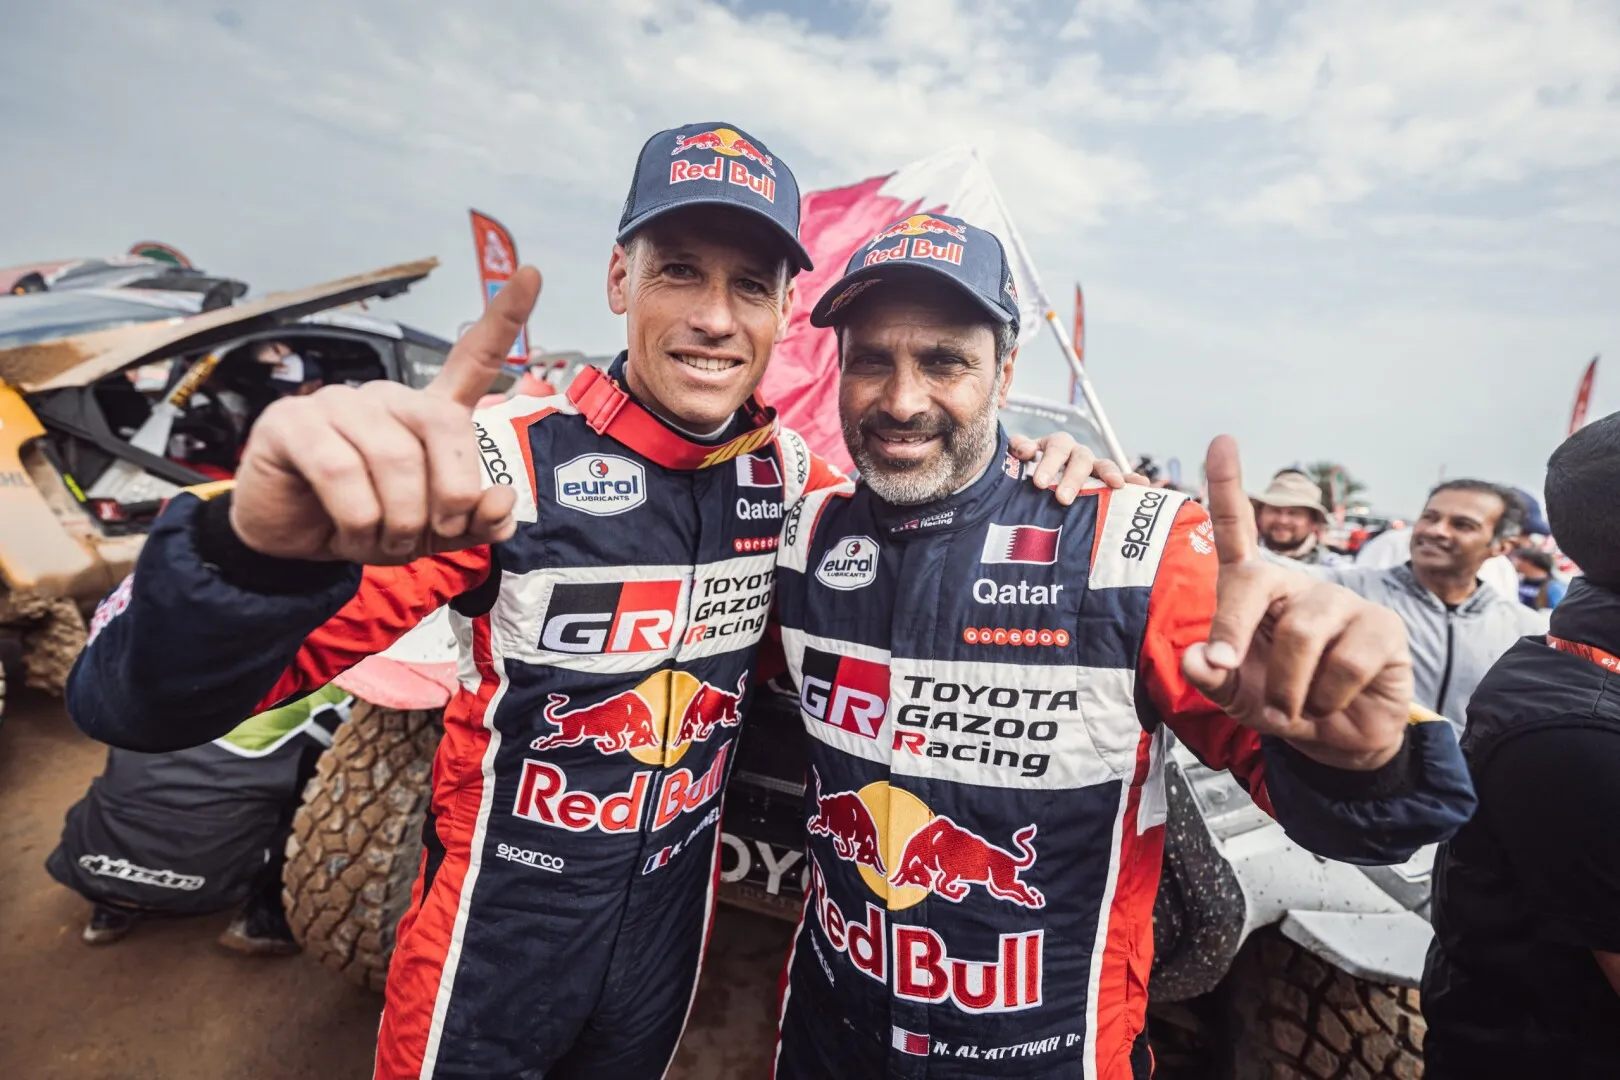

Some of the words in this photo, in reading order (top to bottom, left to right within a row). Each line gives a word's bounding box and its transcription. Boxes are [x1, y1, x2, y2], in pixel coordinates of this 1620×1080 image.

[669, 156, 722, 185] Red
[729, 162, 775, 203] Bull
[863, 239, 908, 266] Red
[912, 239, 964, 265] Bull
[473, 421, 513, 485] parco
[563, 475, 638, 497] eurol
[576, 494, 630, 502] LUBRICANTS
[736, 498, 783, 520] Qatar
[1121, 491, 1168, 561] sparco
[823, 553, 873, 572] eurol
[694, 590, 771, 622] GAZOO
[972, 578, 1064, 605] Qatar
[542, 609, 675, 652] GR
[684, 613, 765, 645] Racing
[965, 629, 1068, 645] ooredoo
[801, 674, 887, 738] GR
[904, 675, 1080, 711] TOYOTA
[897, 704, 1059, 742] GAZOO
[892, 731, 1051, 778] Racing
[512, 758, 652, 834] Red
[652, 738, 732, 832] Bull
[496, 843, 565, 873] sparco
[811, 849, 887, 985] Red
[892, 923, 1045, 1014] Bull
[932, 1041, 951, 1056] N.
[955, 1036, 1061, 1060] AL-ATTIYAH
